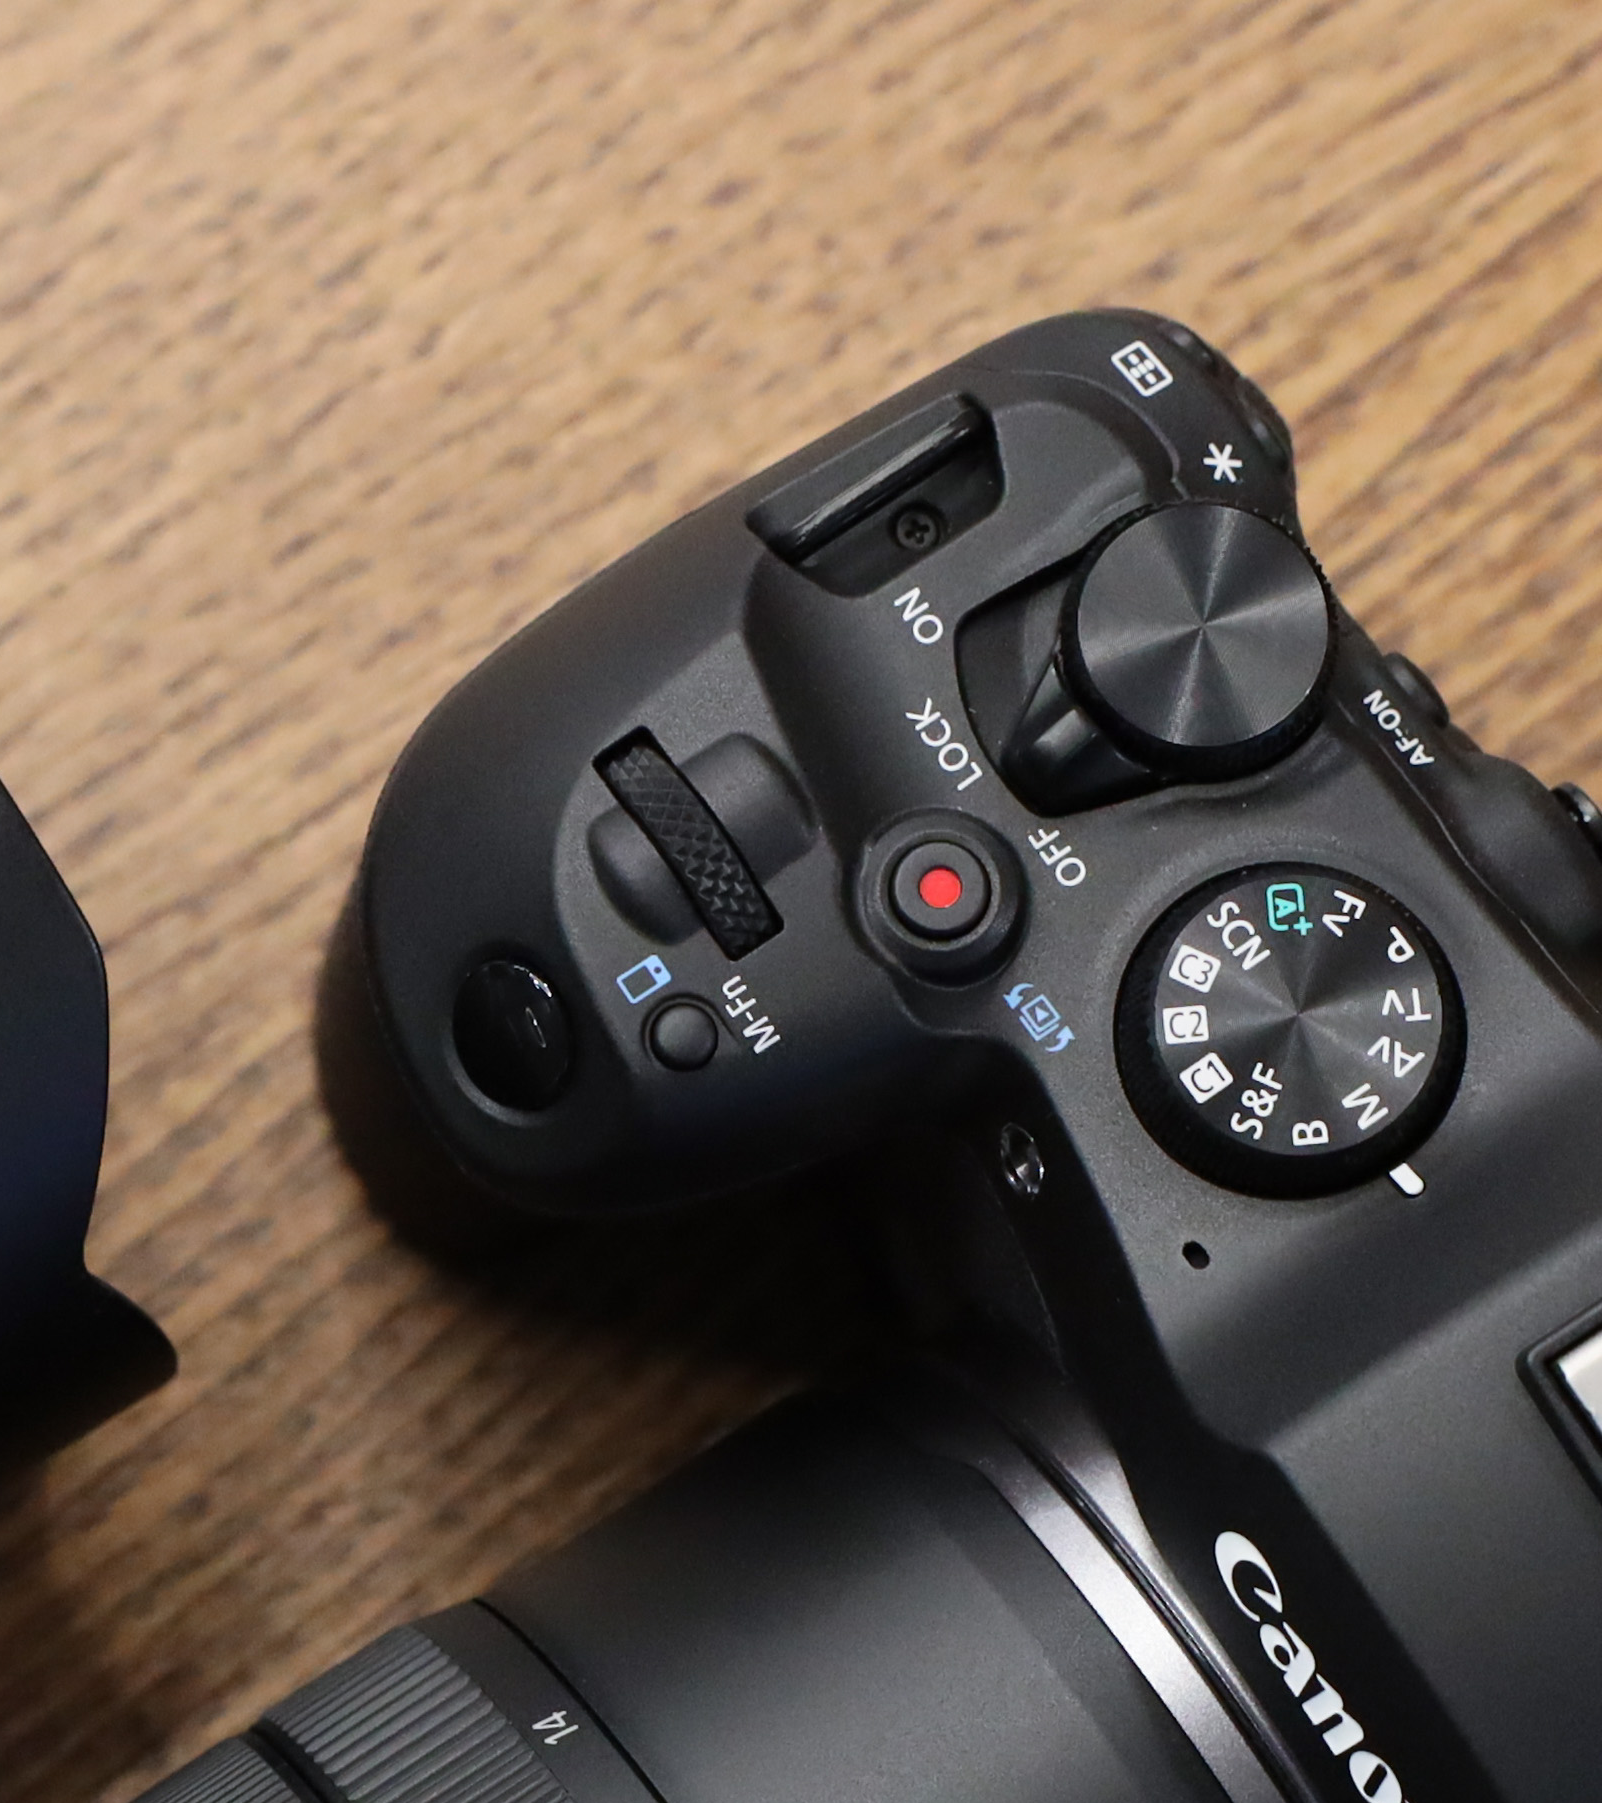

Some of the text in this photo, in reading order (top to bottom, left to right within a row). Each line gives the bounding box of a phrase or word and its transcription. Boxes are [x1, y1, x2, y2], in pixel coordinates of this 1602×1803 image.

[894, 586, 944, 645] ON
[904, 697, 983, 792] LOCK
[1362, 689, 1435, 768] AF-ON
[1028, 827, 1087, 888] OFF
[1206, 901, 1271, 970] SCN
[1322, 890, 1366, 937] Fv
[1387, 926, 1415, 964] P
[721, 974, 781, 1055] M-Fn
[1381, 987, 1432, 1023] Tv
[1367, 1036, 1426, 1078] Av
[1230, 1062, 1283, 1141] S&F
[1341, 1083, 1389, 1130] M
[1292, 1119, 1329, 1146] B
[532, 1710, 579, 1745] 14
